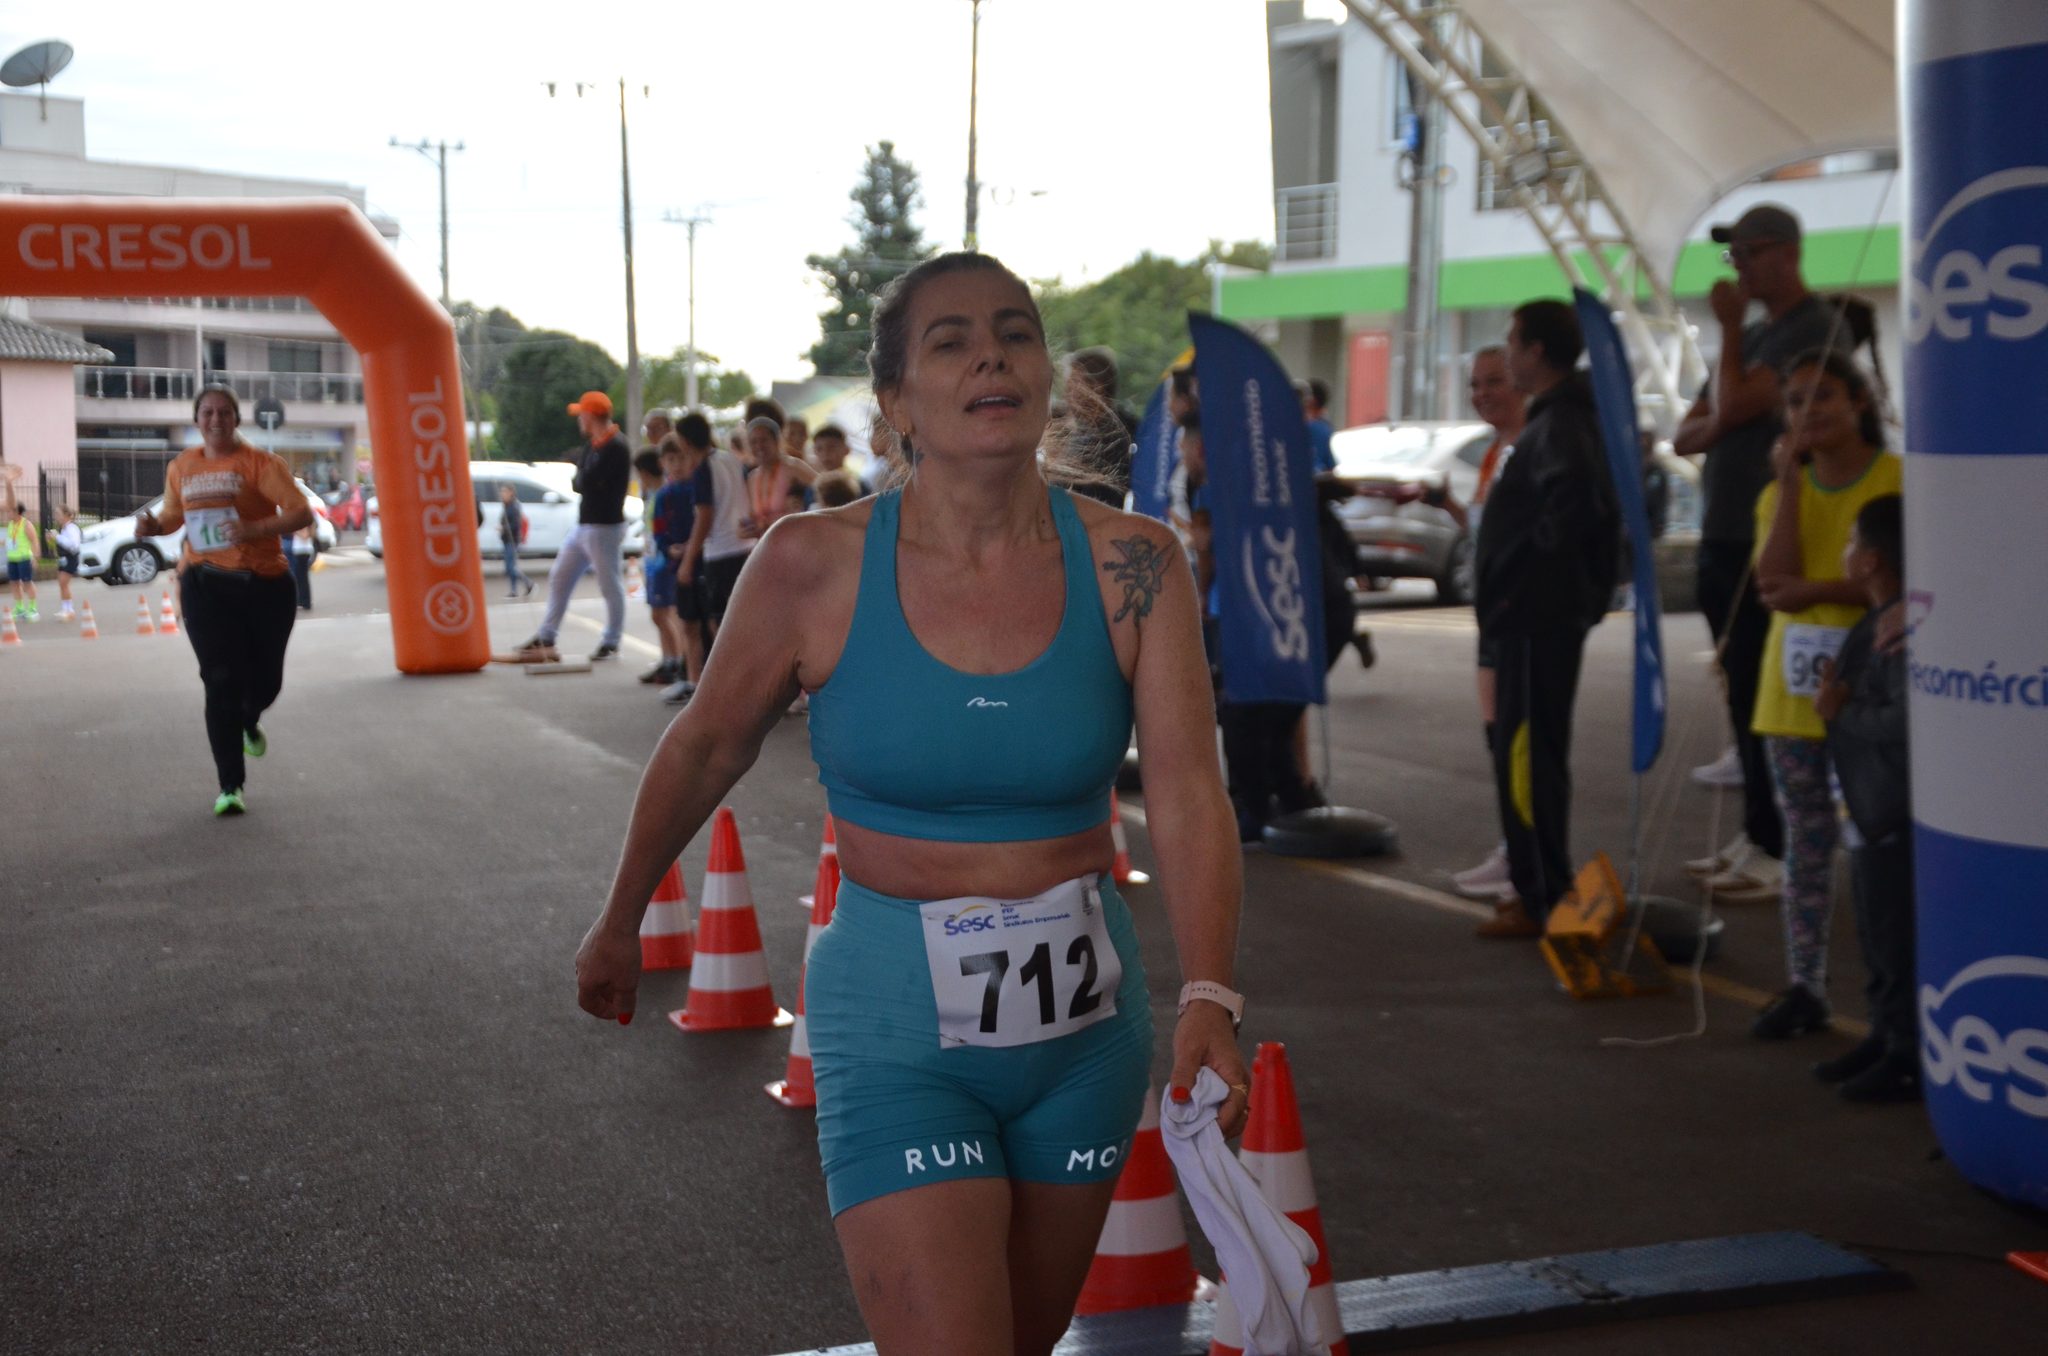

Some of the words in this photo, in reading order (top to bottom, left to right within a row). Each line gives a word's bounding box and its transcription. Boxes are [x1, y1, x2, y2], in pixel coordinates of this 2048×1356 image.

[18, 223, 272, 271] CRESOL
[408, 375, 461, 567] CRESOL
[959, 934, 1103, 1033] 712
[905, 1140, 984, 1174] RUN
